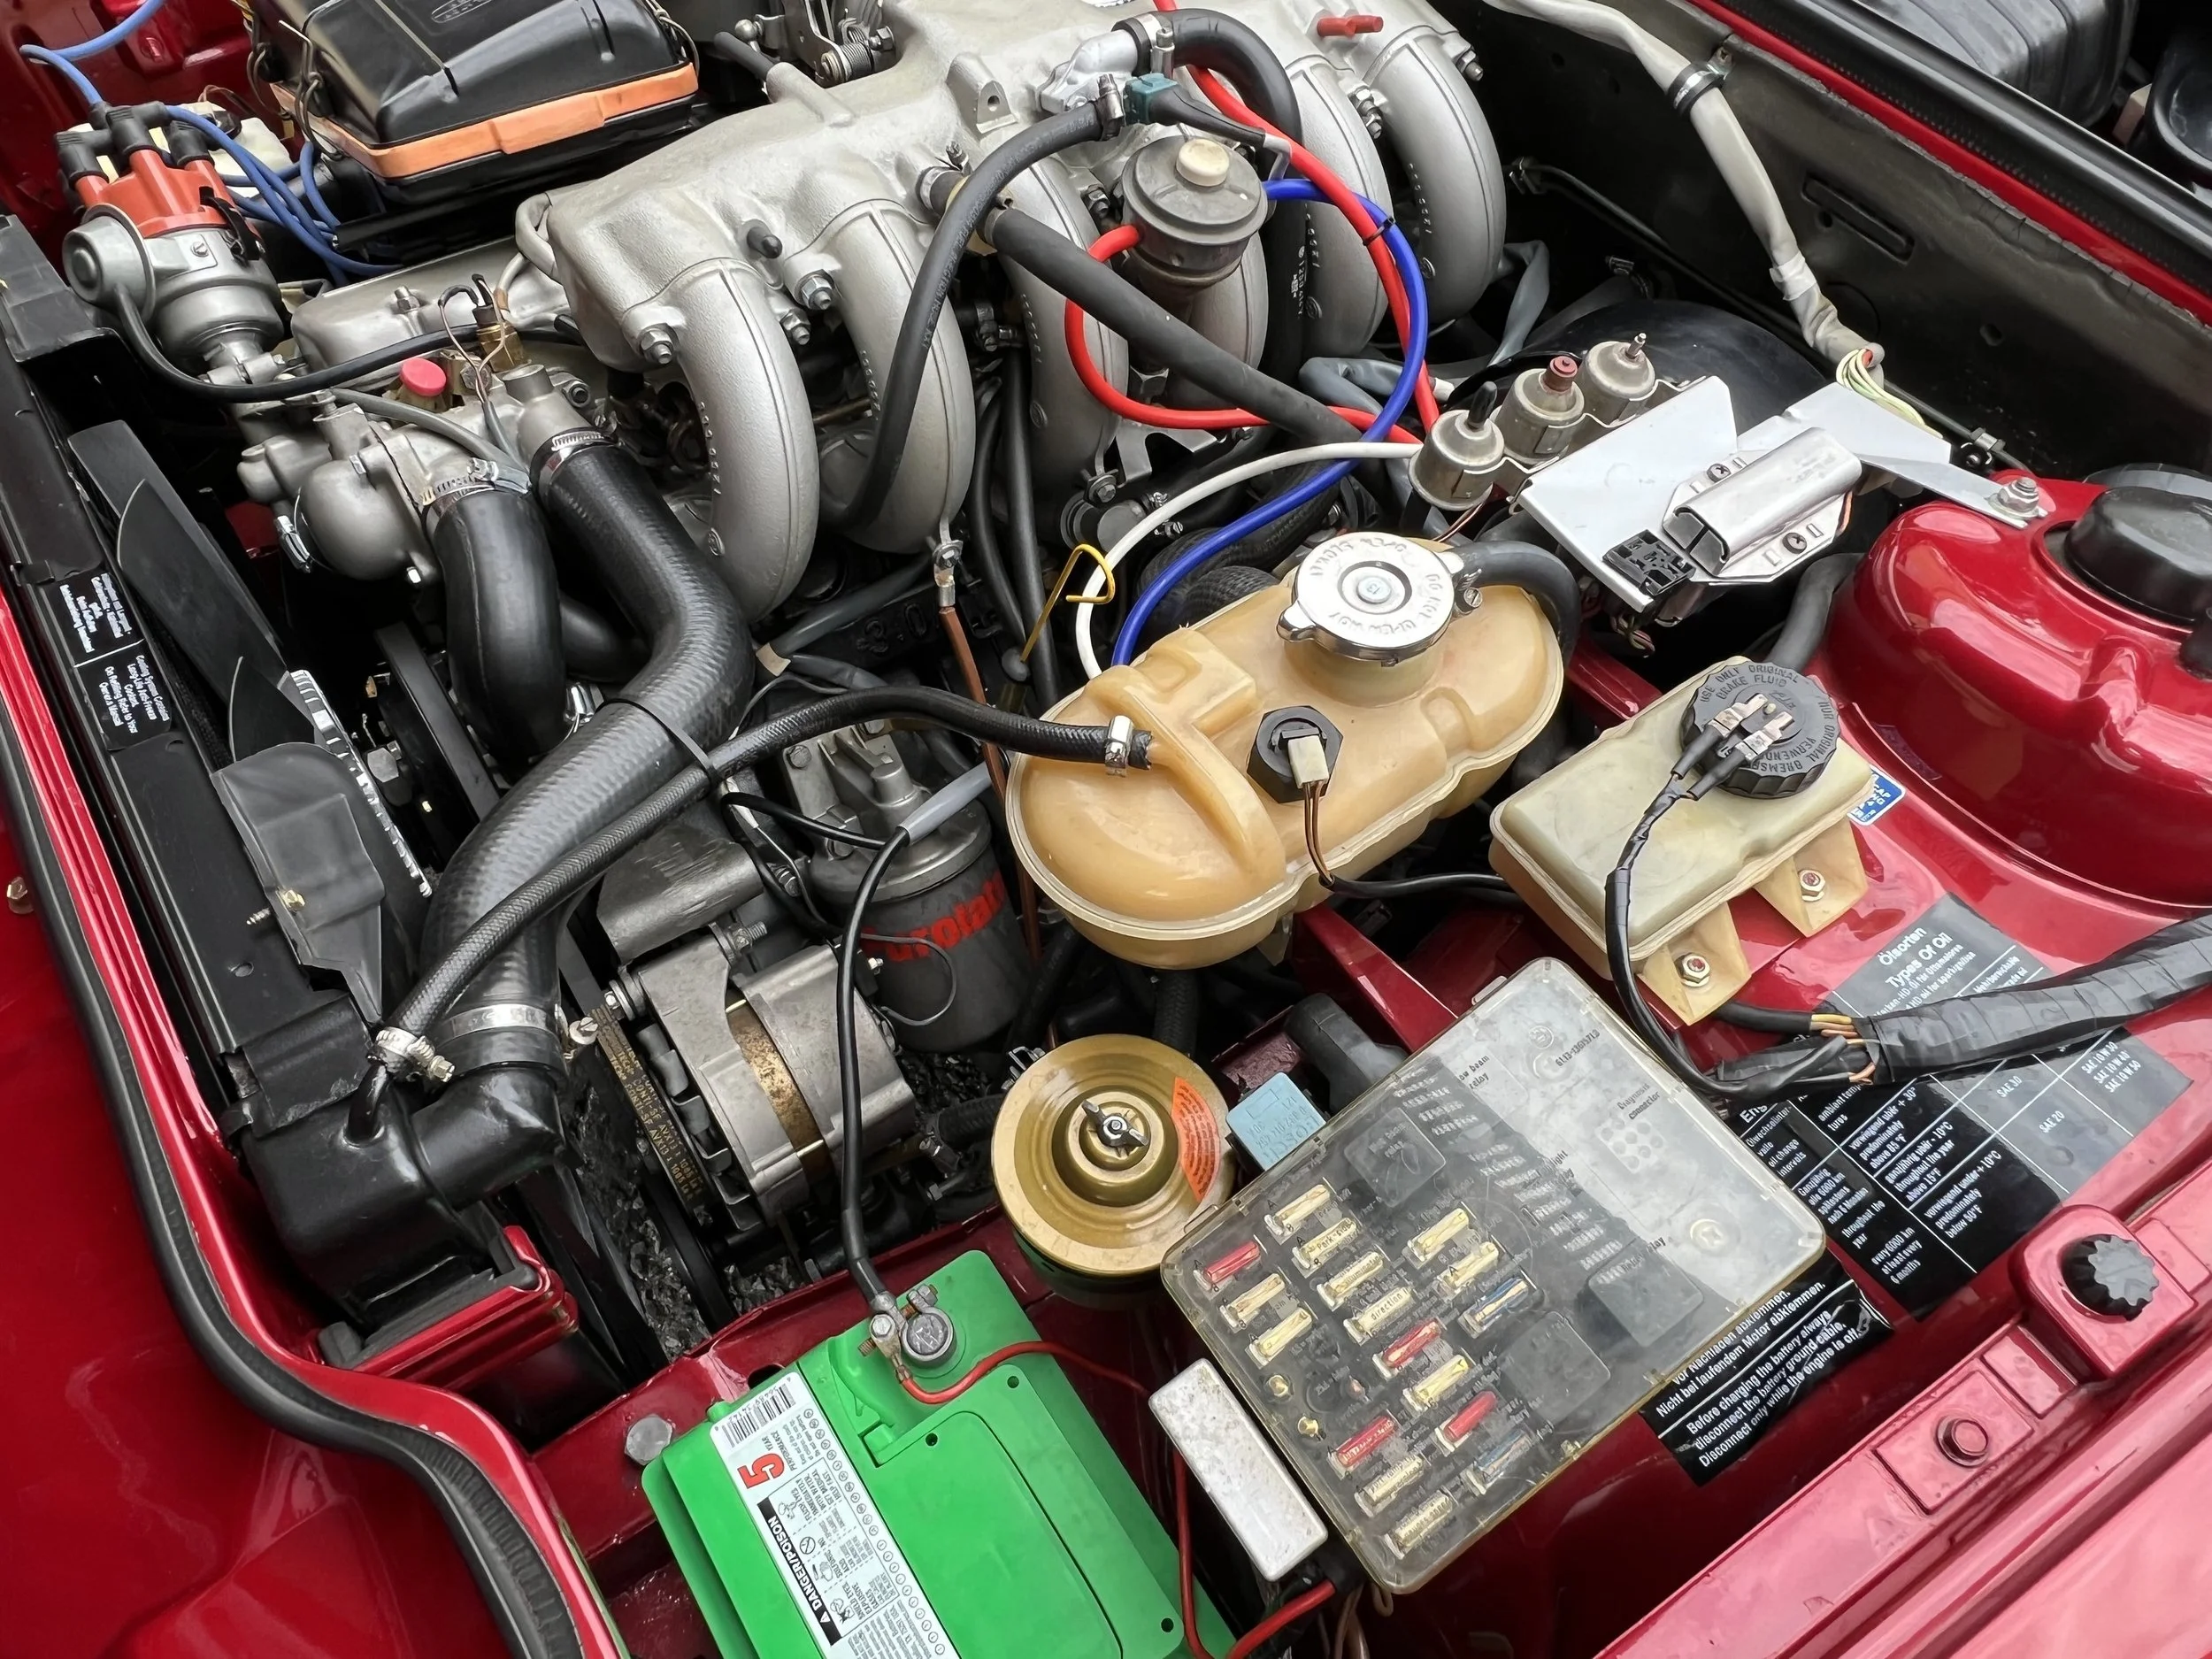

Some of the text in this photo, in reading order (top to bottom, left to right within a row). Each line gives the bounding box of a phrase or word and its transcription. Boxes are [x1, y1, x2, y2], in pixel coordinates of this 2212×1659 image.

[1886, 960, 1922, 987] Types
[1997, 1083, 2013, 1097] SAE
[2039, 1110, 2064, 1133] SAE 20
[1656, 1283, 1824, 1417] Nicht bei laufendem Motor abklemmen.
[1687, 1311, 1832, 1433] Before charging the battery always
[1695, 1323, 1845, 1449] disconnect the battery ground cable.
[1700, 1424, 1751, 1466] Disconnect
[1751, 1406, 1768, 1425] only
[1767, 1385, 1789, 1407] while
[1786, 1372, 1804, 1386] the
[1803, 1348, 1834, 1374] engine
[1832, 1340, 1844, 1350] is
[739, 1454, 784, 1487] 5
[767, 1517, 823, 1609] DANGER/POISON
